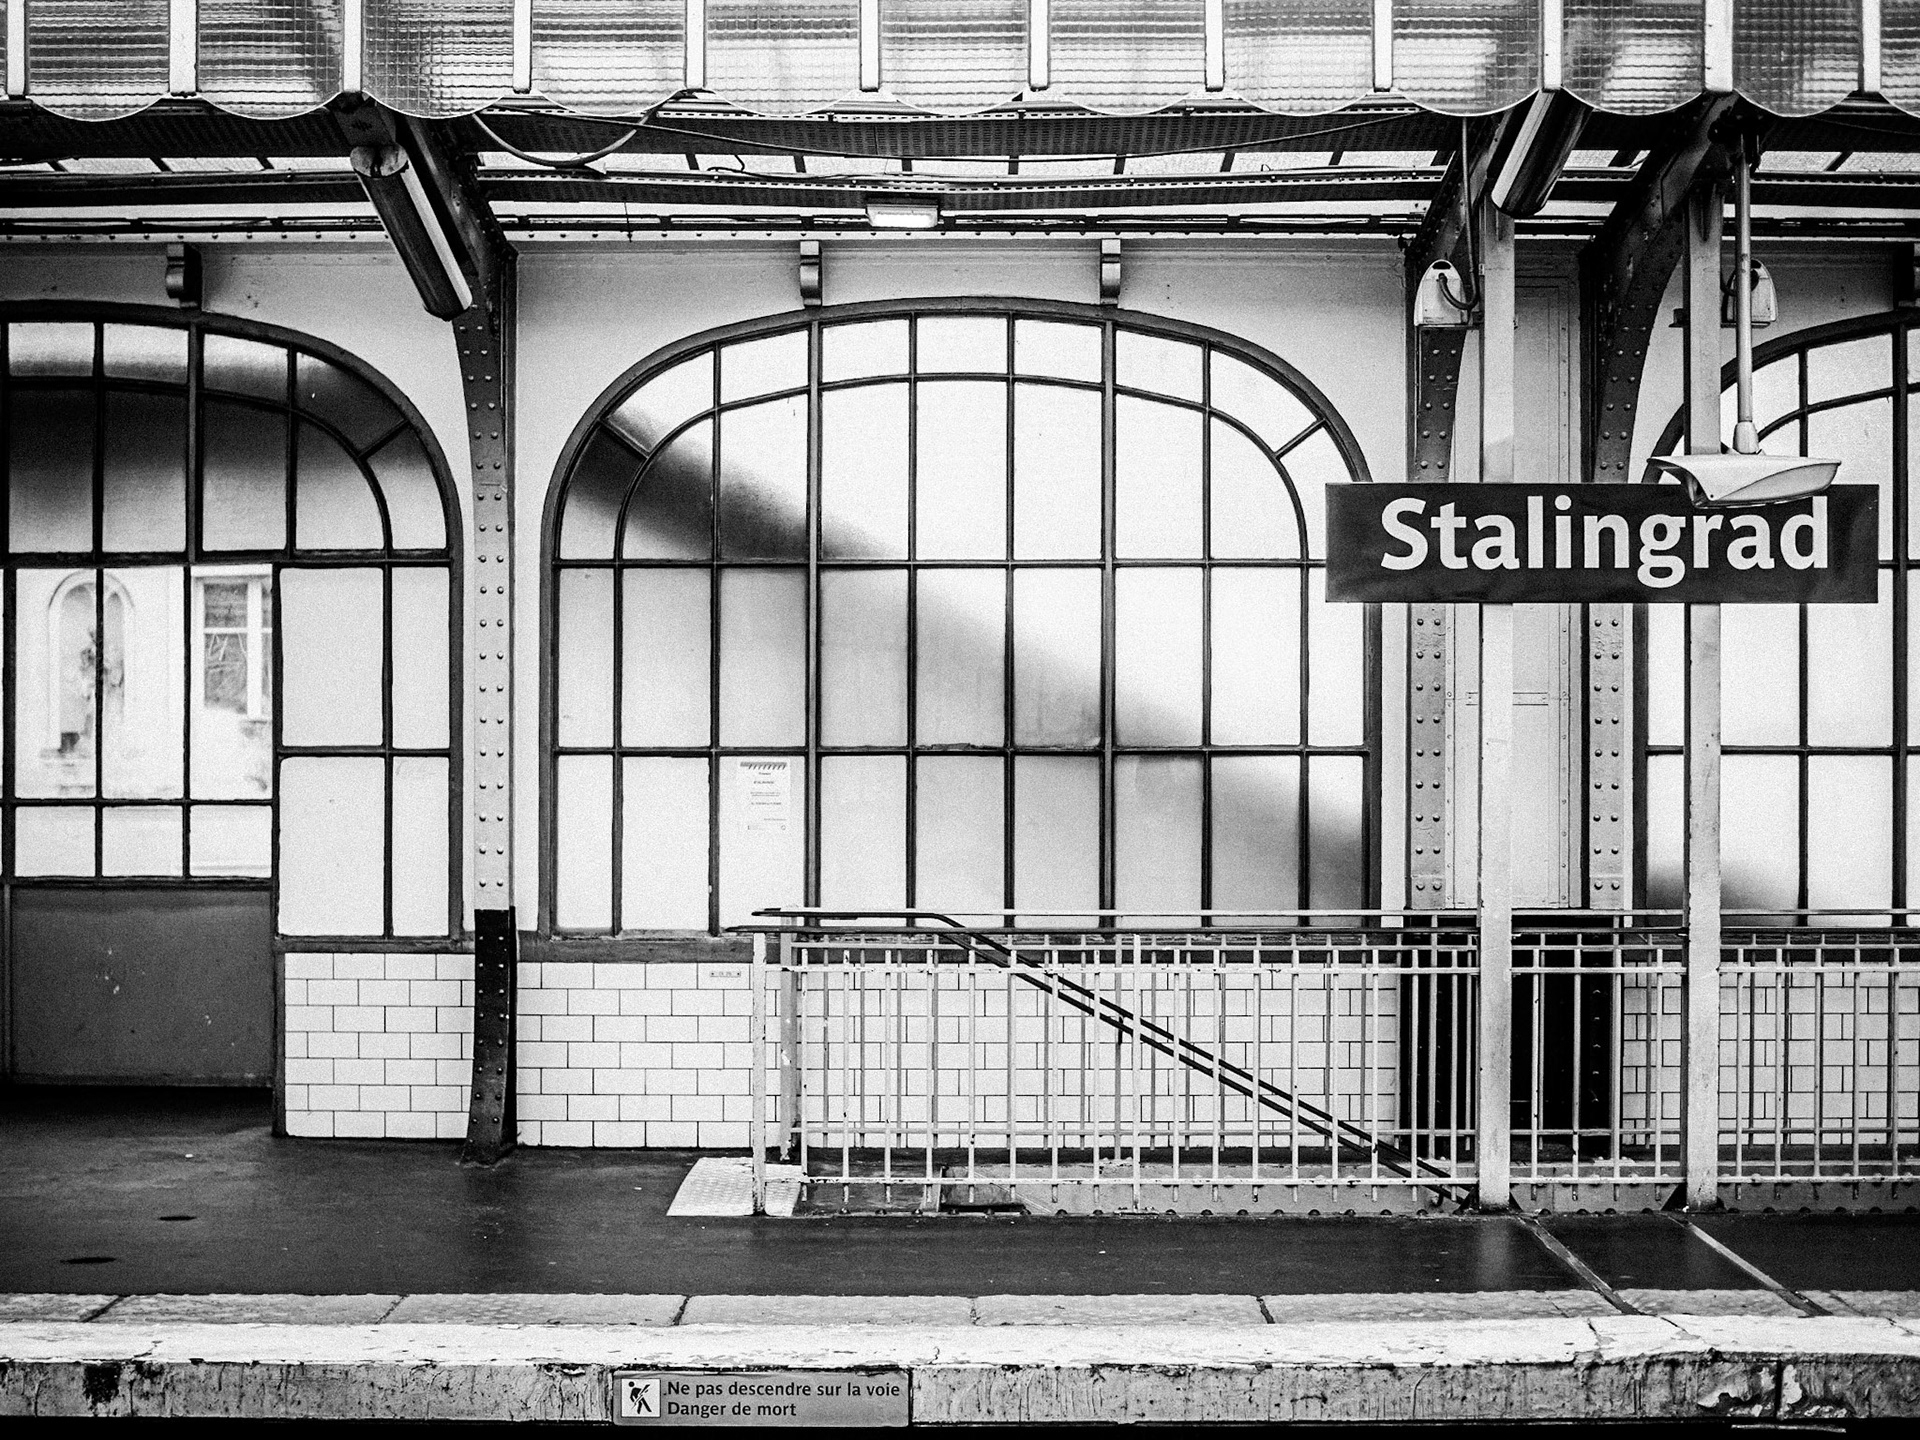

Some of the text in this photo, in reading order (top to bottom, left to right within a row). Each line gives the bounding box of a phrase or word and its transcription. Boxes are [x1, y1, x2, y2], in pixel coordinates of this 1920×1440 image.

[1380, 495, 1829, 589] Stalingrad
[667, 1381, 900, 1399] Ne pas descendre sur la voie
[667, 1401, 797, 1419] Danger de mort
